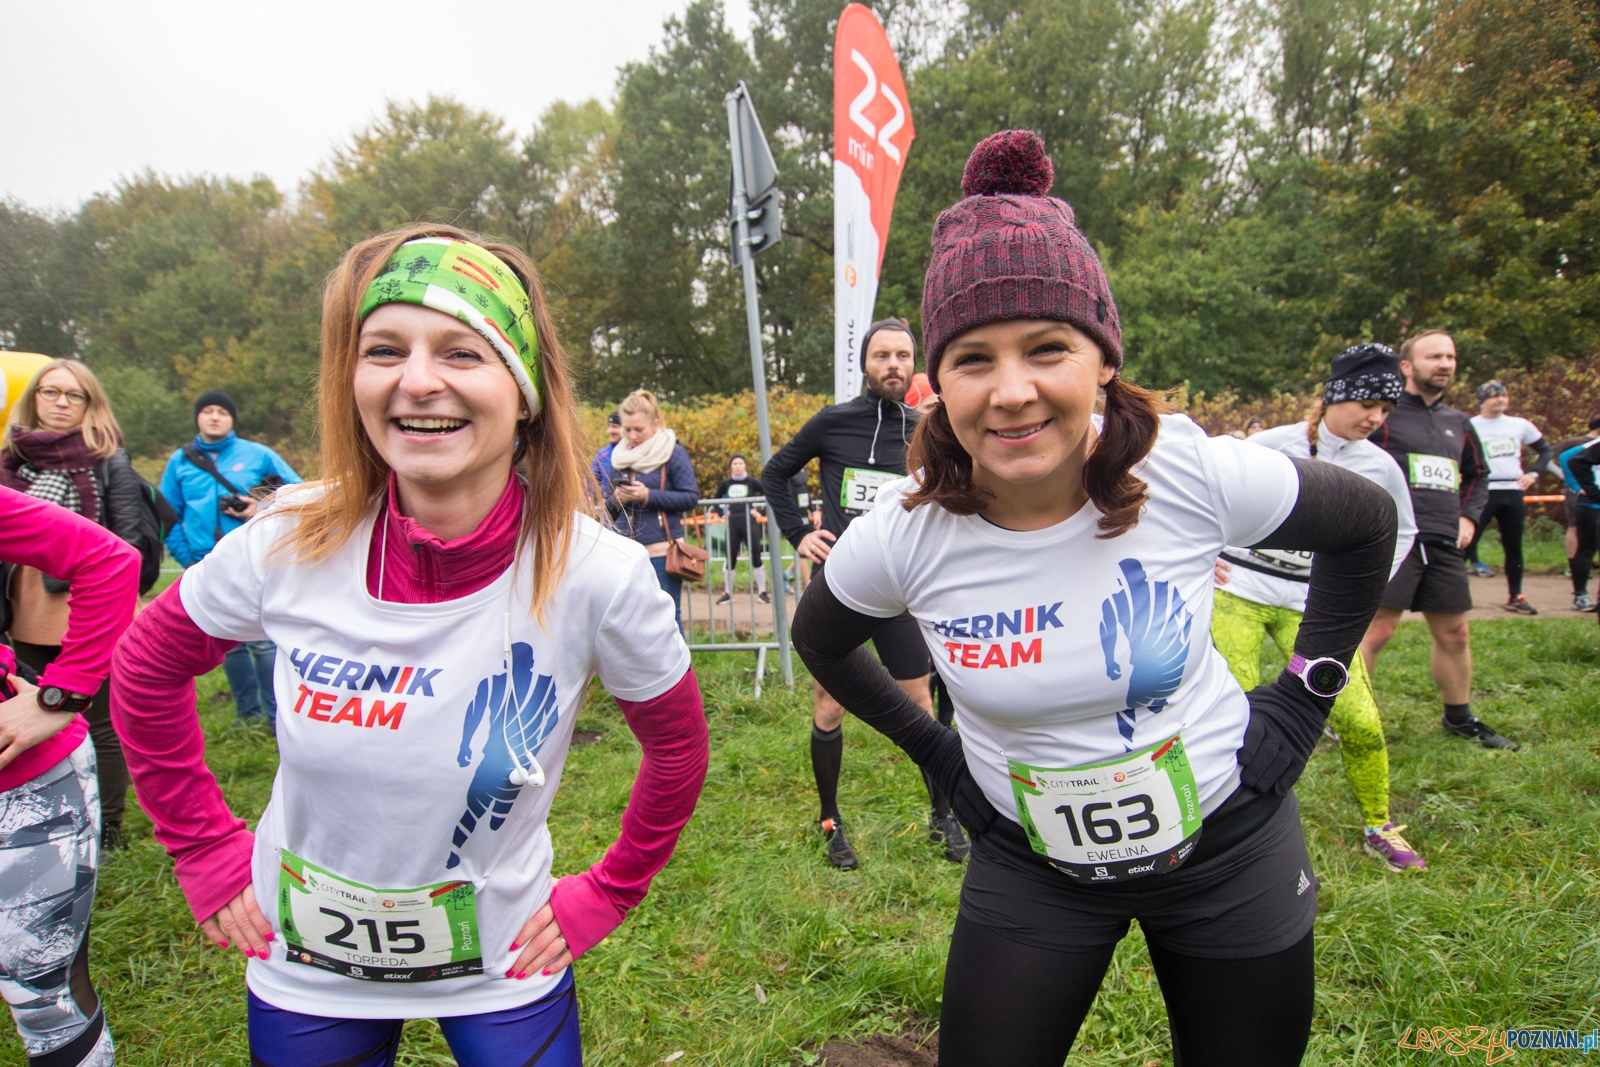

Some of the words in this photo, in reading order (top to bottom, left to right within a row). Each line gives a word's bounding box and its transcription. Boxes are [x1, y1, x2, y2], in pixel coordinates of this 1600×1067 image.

[849, 48, 905, 165] 22
[849, 137, 874, 173] min
[1422, 465, 1452, 481] 842
[943, 637, 1043, 669] TEAM
[293, 683, 407, 730] TEAM
[1054, 794, 1160, 847] 163
[1180, 783, 1195, 822] Poznań
[1087, 844, 1149, 862] EWELINA
[319, 907, 426, 954] 215
[458, 921, 473, 951] Poznań
[344, 952, 409, 967] TORPEDA
